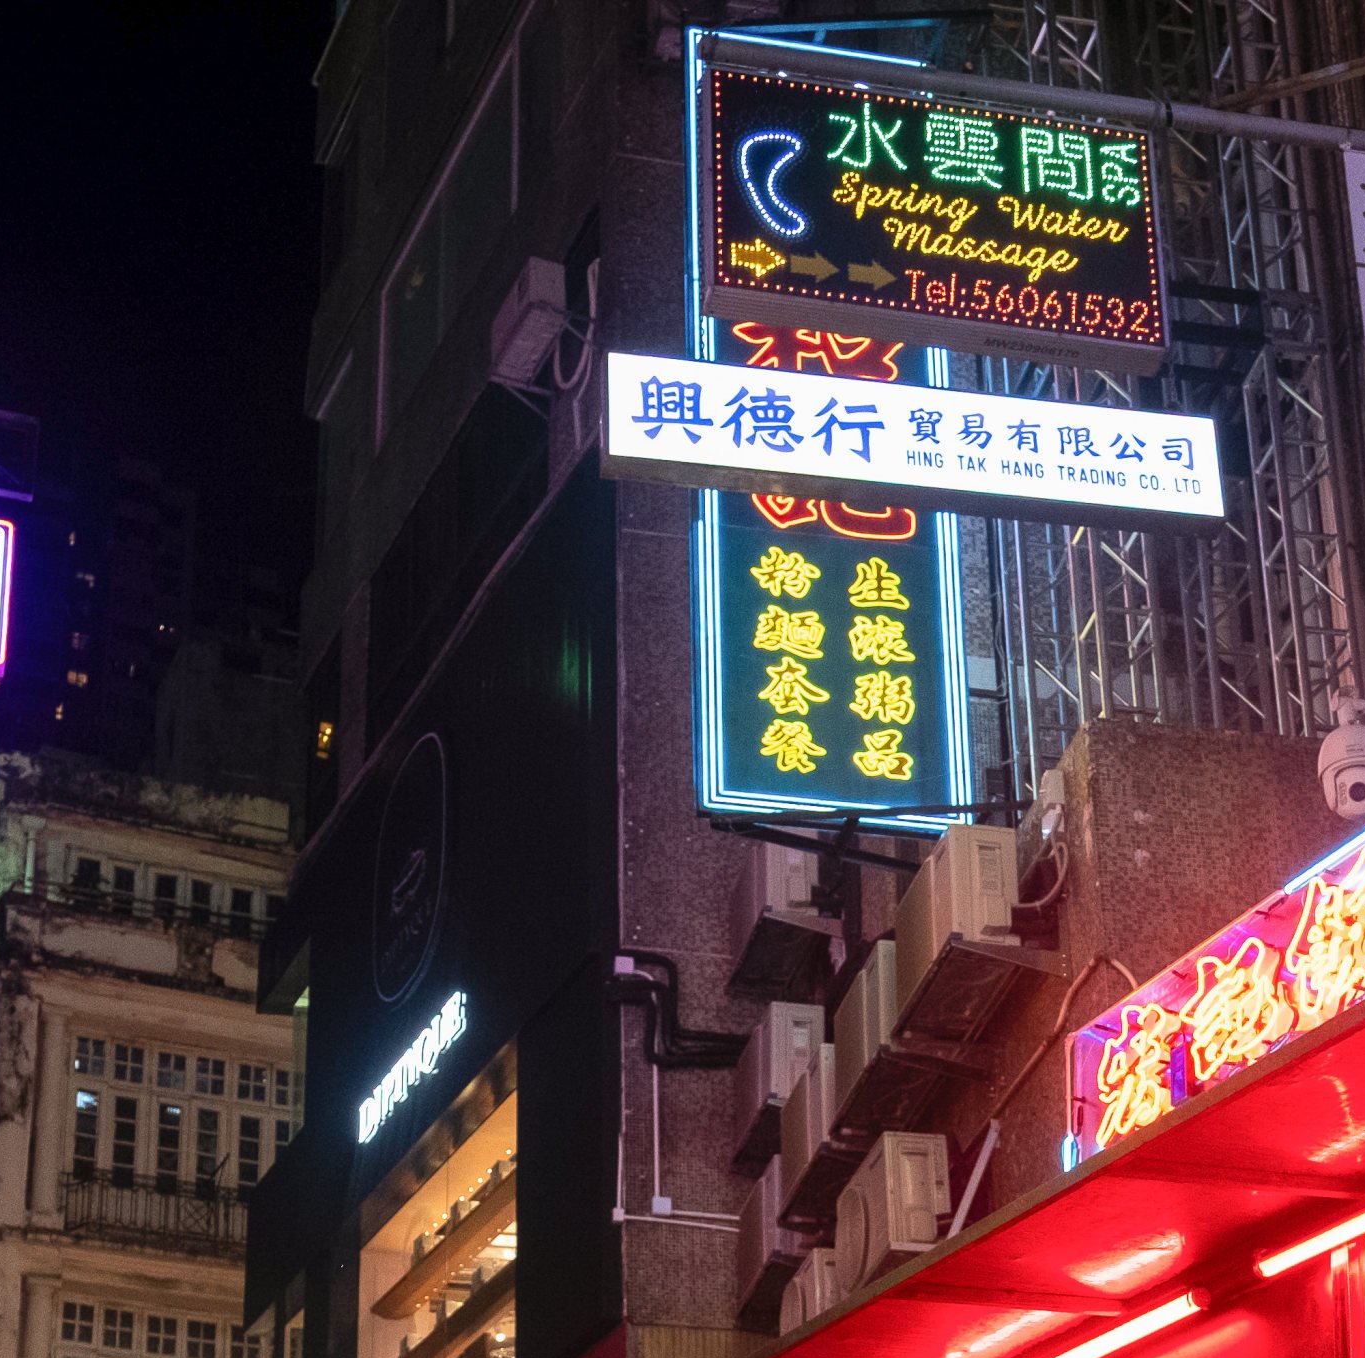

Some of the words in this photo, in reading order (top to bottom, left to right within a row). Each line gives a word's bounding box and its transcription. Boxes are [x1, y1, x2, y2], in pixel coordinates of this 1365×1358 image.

[826, 101, 1094, 201] 水雲間
[1100, 140, 1140, 208] SPA
[831, 170, 978, 230] Spring
[998, 195, 1130, 244] Water
[882, 216, 1078, 282] Massage
[903, 268, 1151, 335] Tel:56061532
[631, 375, 886, 464] 興德行
[906, 405, 1195, 470] 貿易有限公司
[906, 447, 944, 470] HING
[958, 453, 988, 474] TAK
[1000, 457, 1045, 482] HANG
[1057, 463, 1128, 490] TRADING
[1138, 470, 1167, 492] CO.
[1173, 474, 1202, 495] LTD
[750, 546, 830, 774] 粉麵套餐
[848, 556, 916, 780] 生滾粥品
